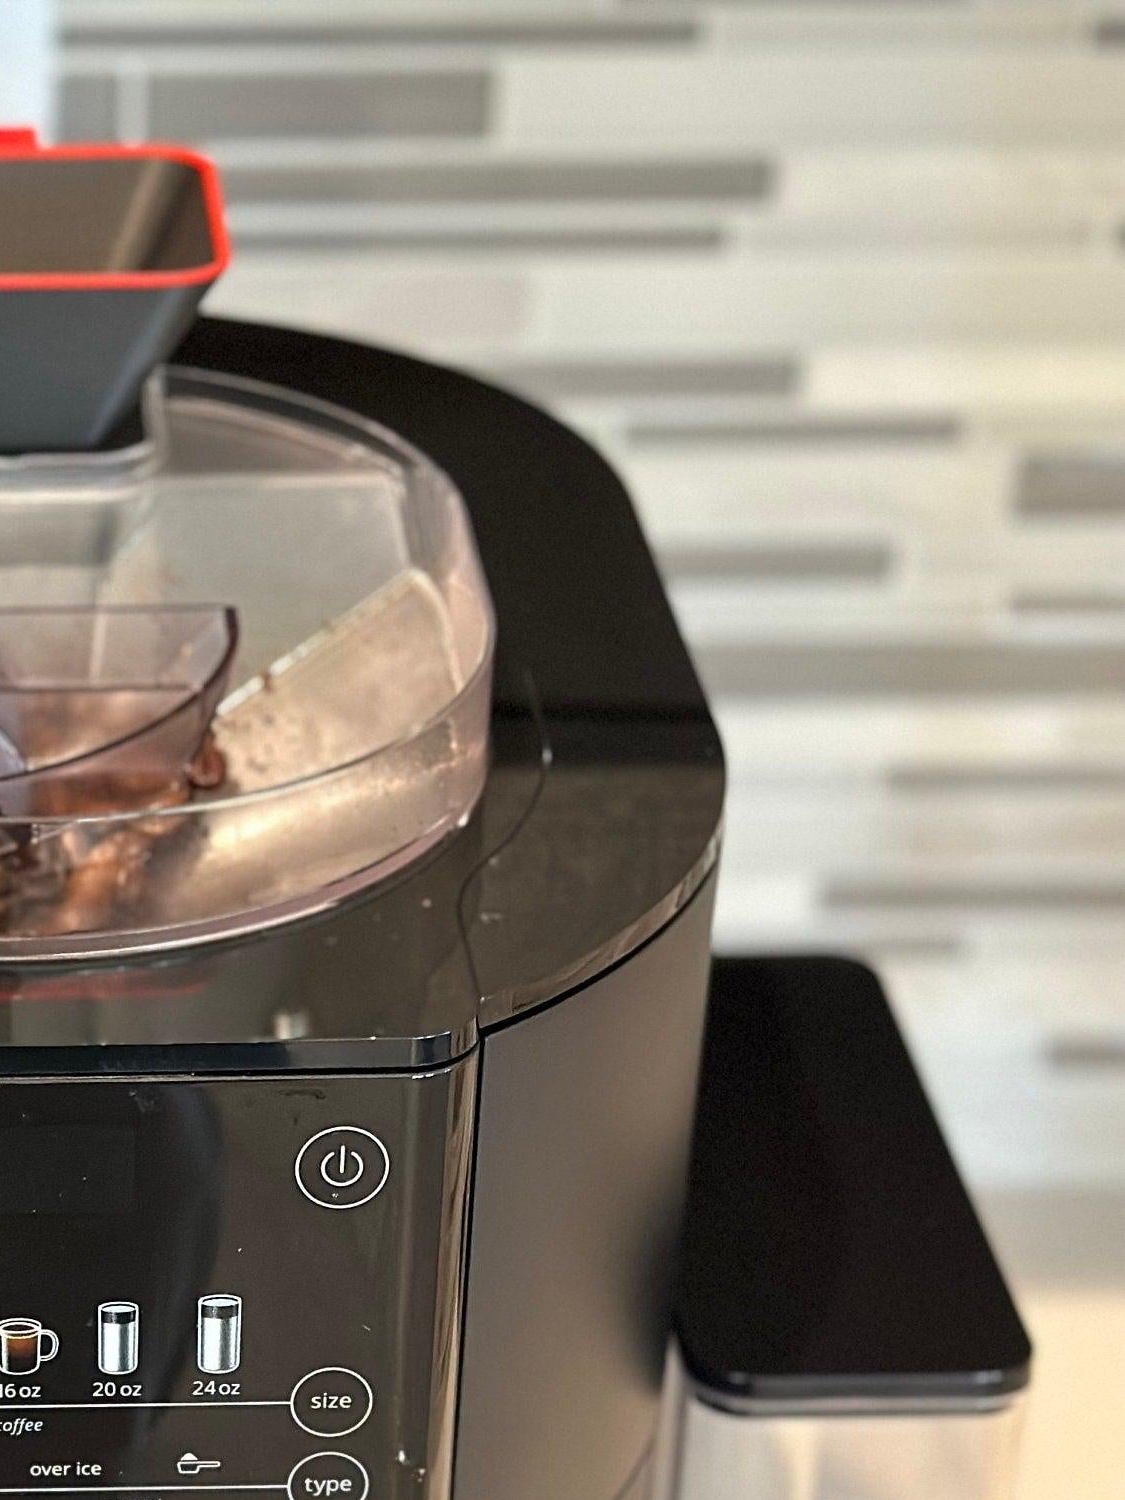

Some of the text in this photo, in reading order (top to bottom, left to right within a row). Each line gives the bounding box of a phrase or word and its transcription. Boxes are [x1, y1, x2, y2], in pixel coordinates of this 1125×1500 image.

[18, 1386, 42, 1398] oz
[92, 1381, 142, 1397] 20 oz
[191, 1380, 241, 1396] 24 oz
[310, 1392, 352, 1410] size
[29, 1461, 102, 1477] over ice
[304, 1477, 352, 1497] type
